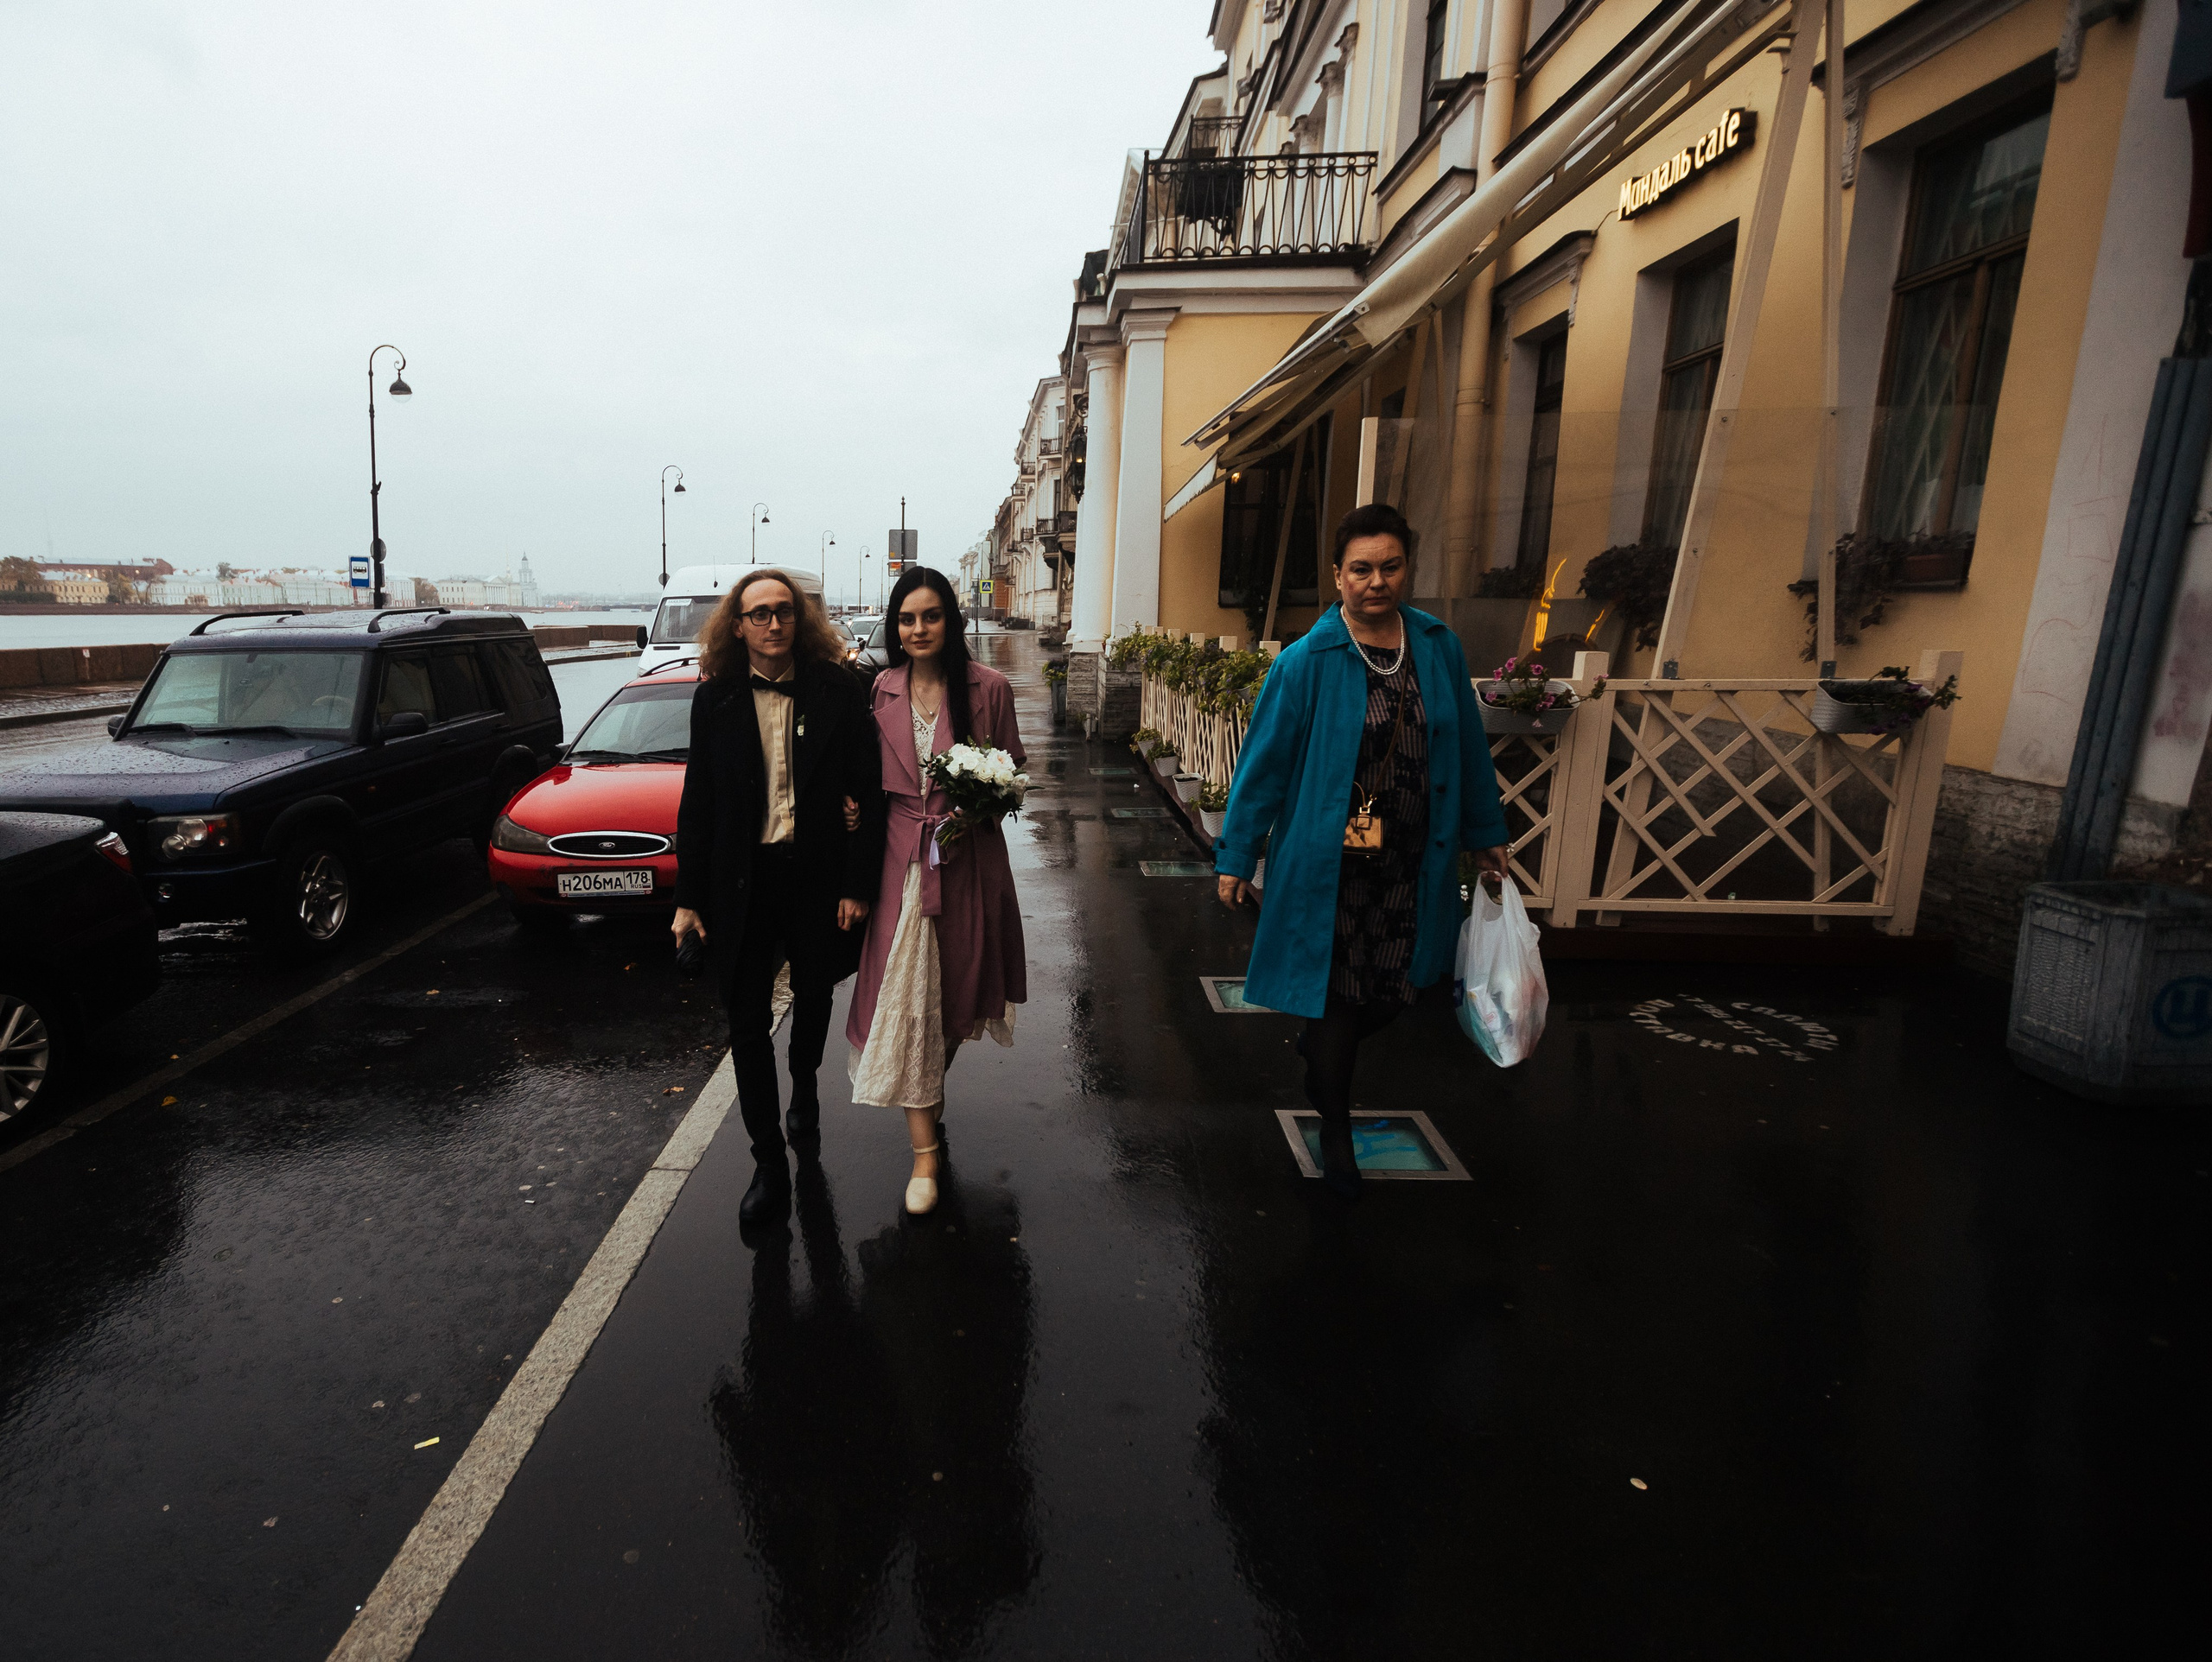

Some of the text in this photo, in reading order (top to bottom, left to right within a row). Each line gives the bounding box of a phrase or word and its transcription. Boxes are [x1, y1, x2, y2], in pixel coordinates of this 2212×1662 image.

[1618, 109, 1741, 221] Мандаль cafe
[626, 872, 648, 885] 178
[1628, 999, 1759, 1056] ДОСТАВКА
[1731, 1002, 1840, 1051] САЛЮТЫ
